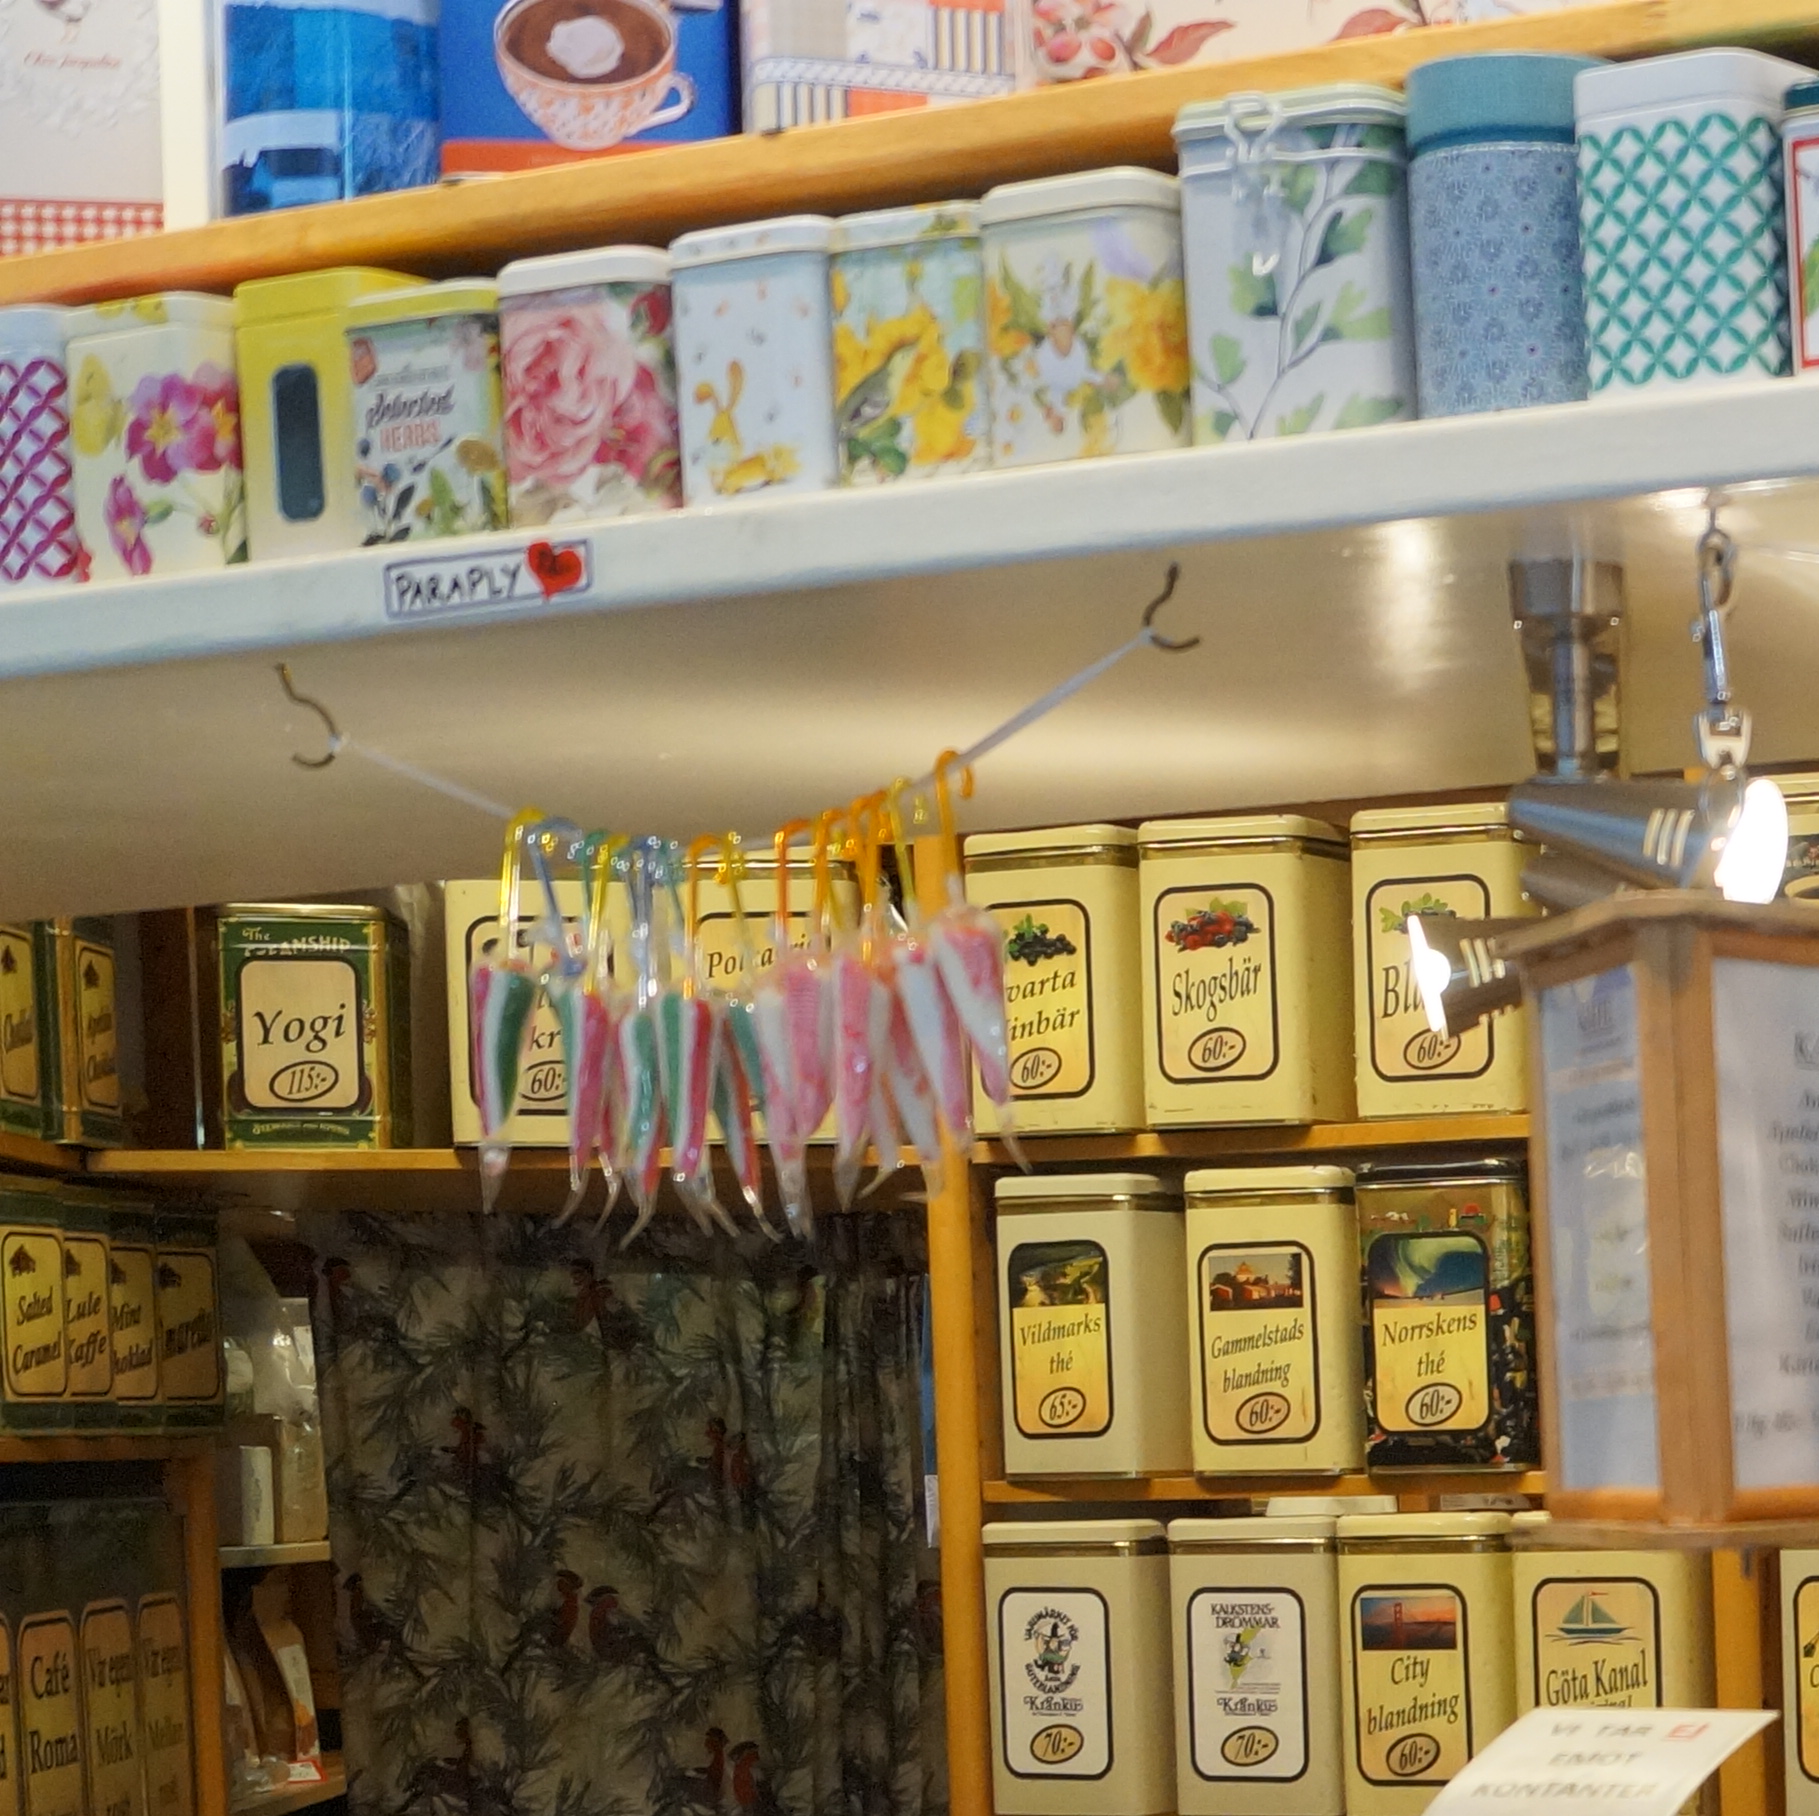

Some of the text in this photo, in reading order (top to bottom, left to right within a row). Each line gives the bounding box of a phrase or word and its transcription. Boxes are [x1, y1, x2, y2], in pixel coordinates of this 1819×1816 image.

[395, 564, 522, 611] PARAPLY
[1172, 956, 1263, 1021] Skogsbär
[252, 1002, 347, 1053] Yogi
[1202, 1036, 1237, 1062] 60:-
[287, 1068, 327, 1095] 115:-
[1021, 1057, 1053, 1082] 60:-
[1019, 1313, 1101, 1346] Vildmarks
[1211, 1319, 1305, 1359] Gammelstads
[1382, 1311, 1478, 1346] Norrskens
[1048, 1350, 1073, 1372] thé
[1417, 1352, 1445, 1376] thé
[1223, 1361, 1292, 1394] blandning
[1248, 1396, 1282, 1424] 60:-
[1419, 1388, 1456, 1418] 60:-
[1211, 1603, 1275, 1615] KALKSTENS-
[1215, 1615, 1280, 1629] DRÖMMAR
[30, 1653, 69, 1700] Café
[1391, 1654, 1431, 1688] City
[1546, 1649, 1649, 1706] Göta Kanal
[1367, 1692, 1460, 1735] blandning
[1044, 1732, 1074, 1755] 70:-
[1236, 1733, 1269, 1756] 70:-
[1551, 1723, 1578, 1737] VI
[1597, 1724, 1653, 1737] TAR
[29, 1729, 78, 1775] Roma
[1399, 1738, 1431, 1769] 60:-
[1549, 1751, 1643, 1766] EMOT
[1471, 1782, 1658, 1799] KONTANTER
